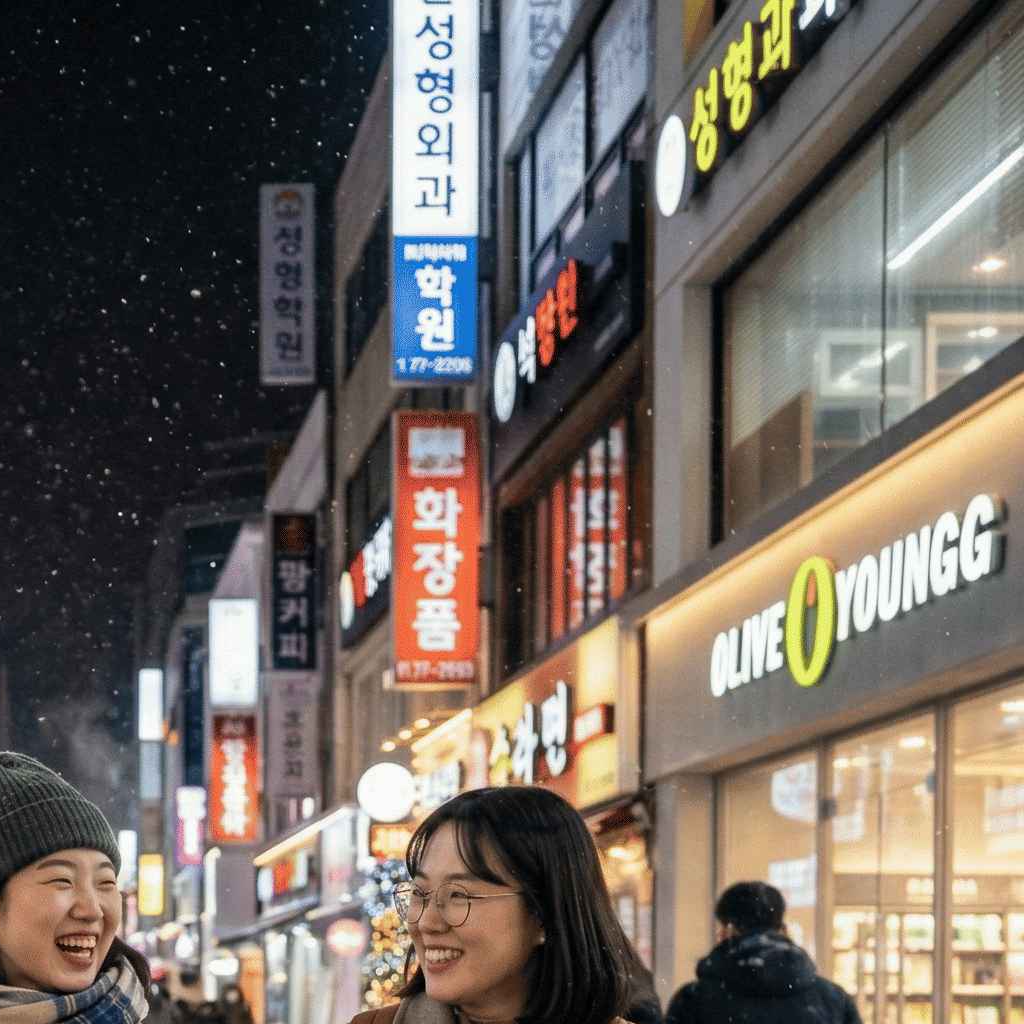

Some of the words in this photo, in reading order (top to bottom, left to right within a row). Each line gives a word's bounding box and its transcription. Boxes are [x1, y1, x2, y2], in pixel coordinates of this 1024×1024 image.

[415, 0, 456, 216] 성형외과
[412, 486, 464, 652] 화장품
[711, 600, 786, 698] OLIVE
[835, 493, 995, 642] YOUNGG
